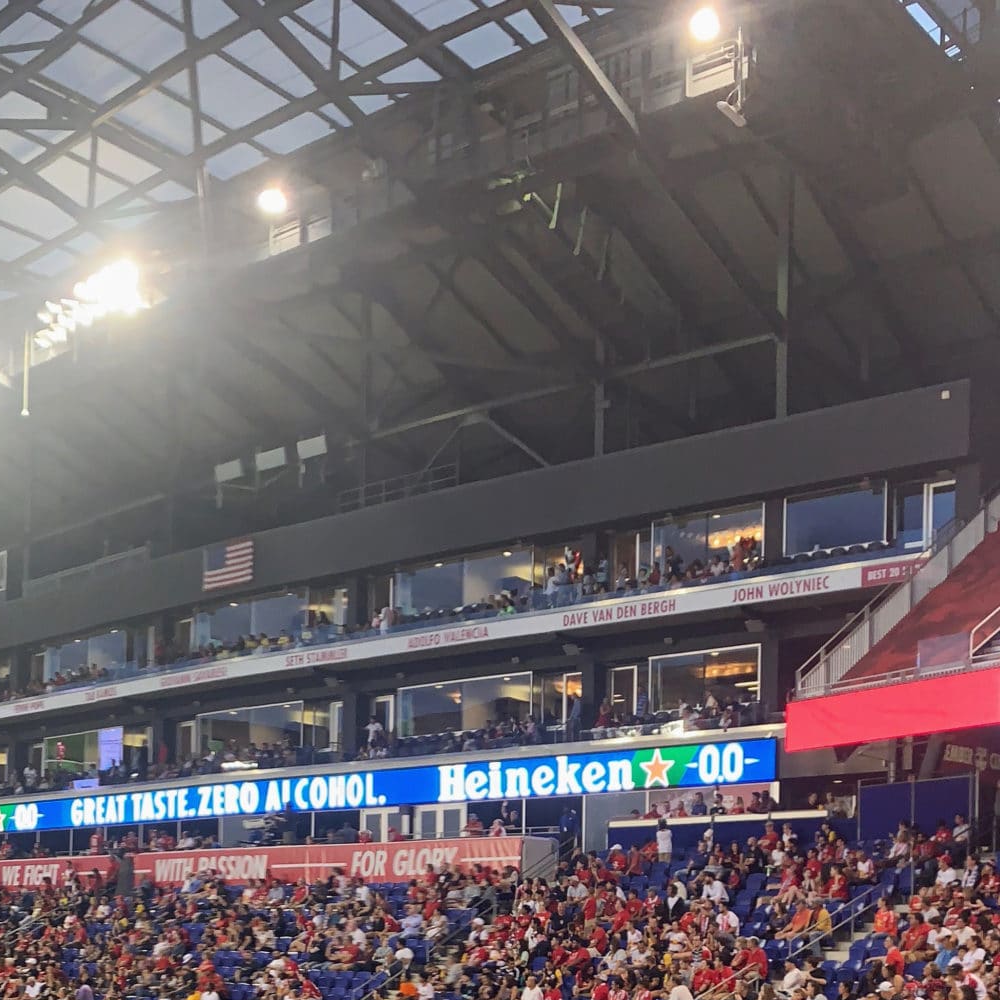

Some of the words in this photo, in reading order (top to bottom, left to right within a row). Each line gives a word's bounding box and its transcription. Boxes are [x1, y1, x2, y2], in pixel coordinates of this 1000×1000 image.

[732, 586, 763, 603] JOHN
[768, 575, 830, 601] WOLYNIEC
[562, 612, 588, 627] DAVE
[592, 607, 613, 622] VAN
[616, 604, 637, 619] DEN
[640, 599, 676, 616] BERGH
[438, 755, 635, 801] Heineken
[698, 742, 744, 784] 0.0
[70, 795, 127, 827] GREAT
[133, 785, 196, 822] TASTE.
[197, 781, 260, 816] ZERO
[2, 867, 21, 887] WE
[24, 863, 60, 886] FIGHT
[155, 858, 191, 883] WITH
[351, 849, 386, 877] FOR
